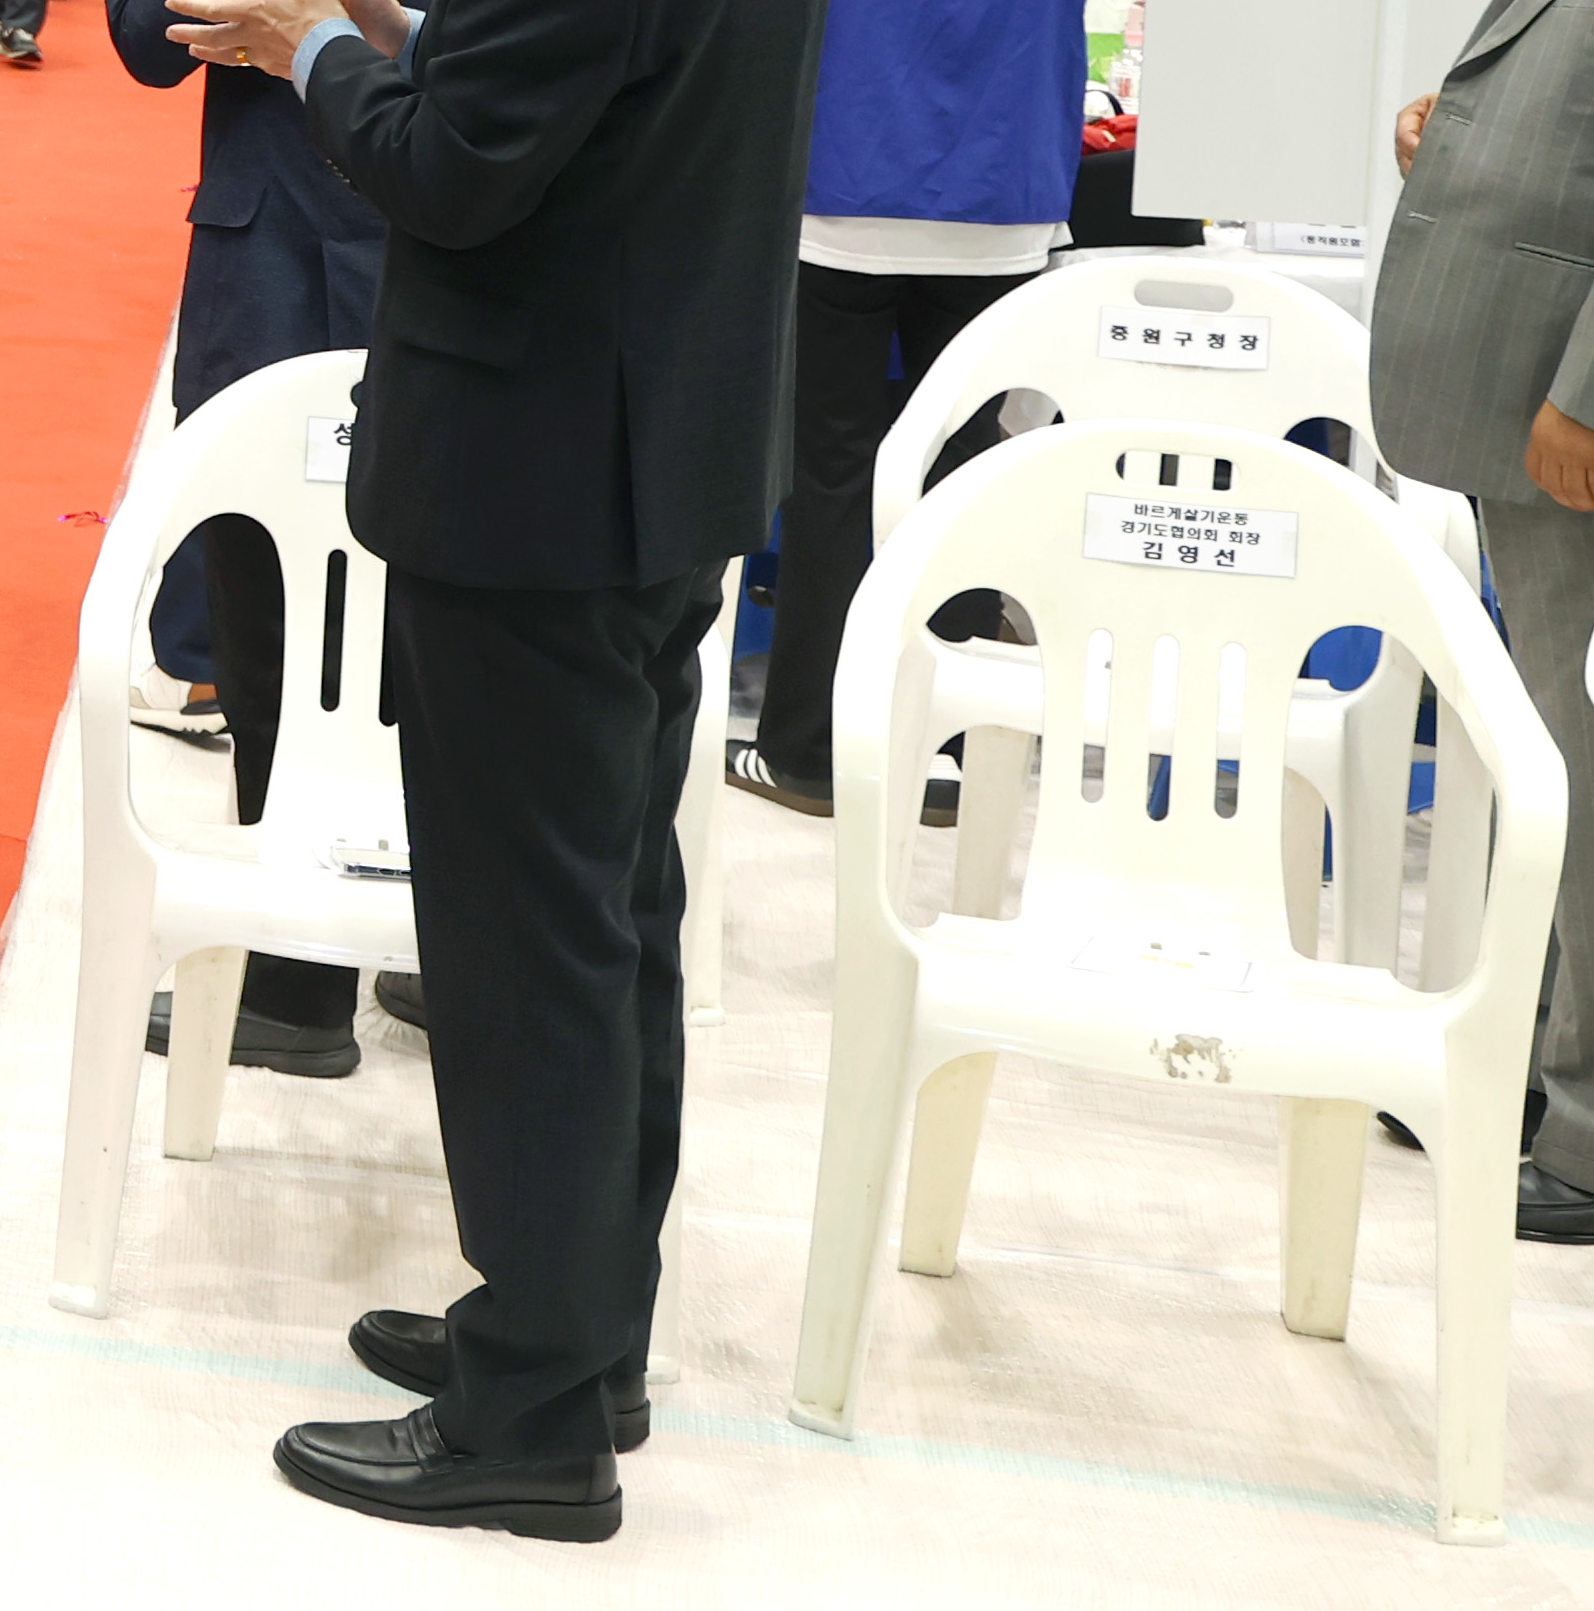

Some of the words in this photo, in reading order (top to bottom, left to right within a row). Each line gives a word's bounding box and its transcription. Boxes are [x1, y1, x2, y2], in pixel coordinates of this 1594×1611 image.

[1110, 324, 1260, 352] 중원구청장
[1133, 502, 1249, 527] 바르게살기운동
[1120, 519, 1219, 543] 경기도협의회
[1228, 528, 1261, 546] 회장
[1141, 541, 1237, 569] 김영선
